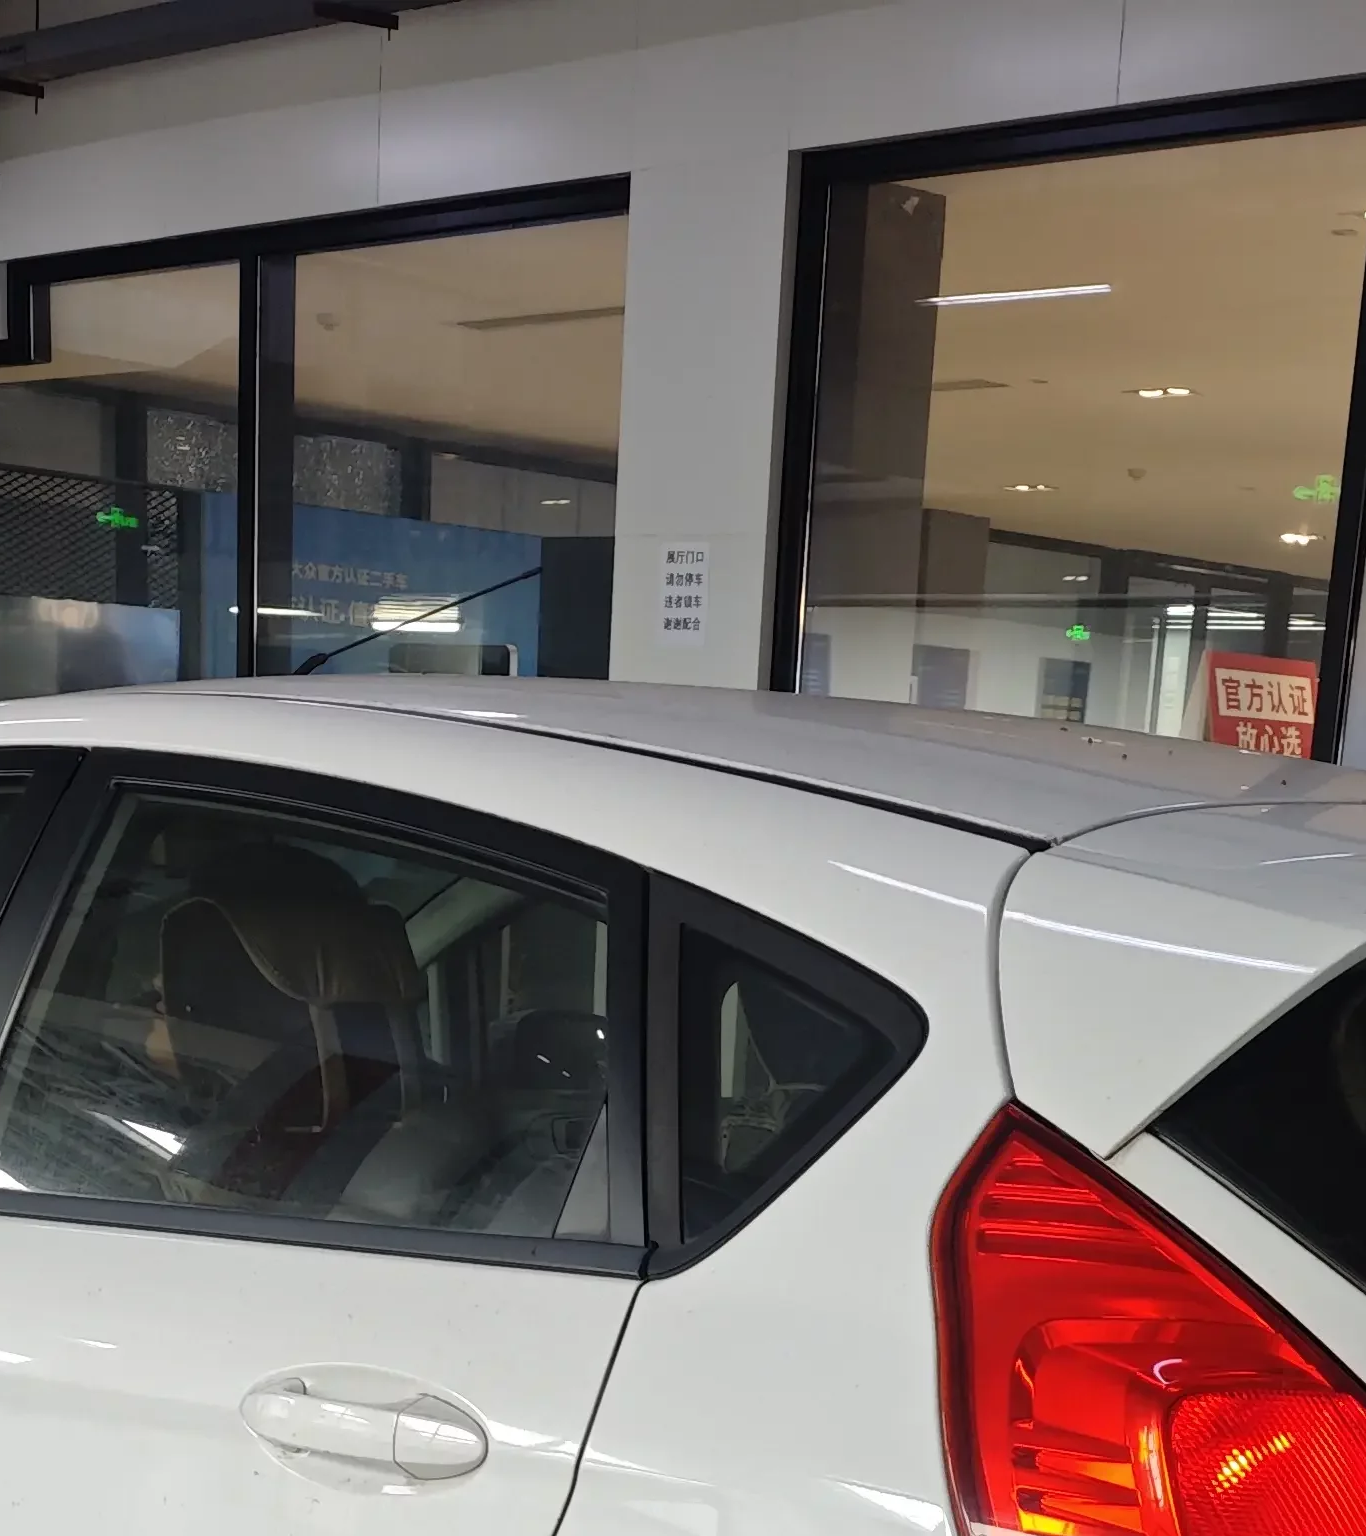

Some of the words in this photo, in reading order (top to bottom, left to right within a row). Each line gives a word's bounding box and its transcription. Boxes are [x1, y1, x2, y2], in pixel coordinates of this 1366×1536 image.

[666, 550, 704, 564] 展厅门口
[665, 572, 704, 587] 请勿停车
[663, 616, 701, 631] 谢谢配合
[1221, 676, 1310, 717] 官方认证
[1236, 721, 1303, 758] 放心选
